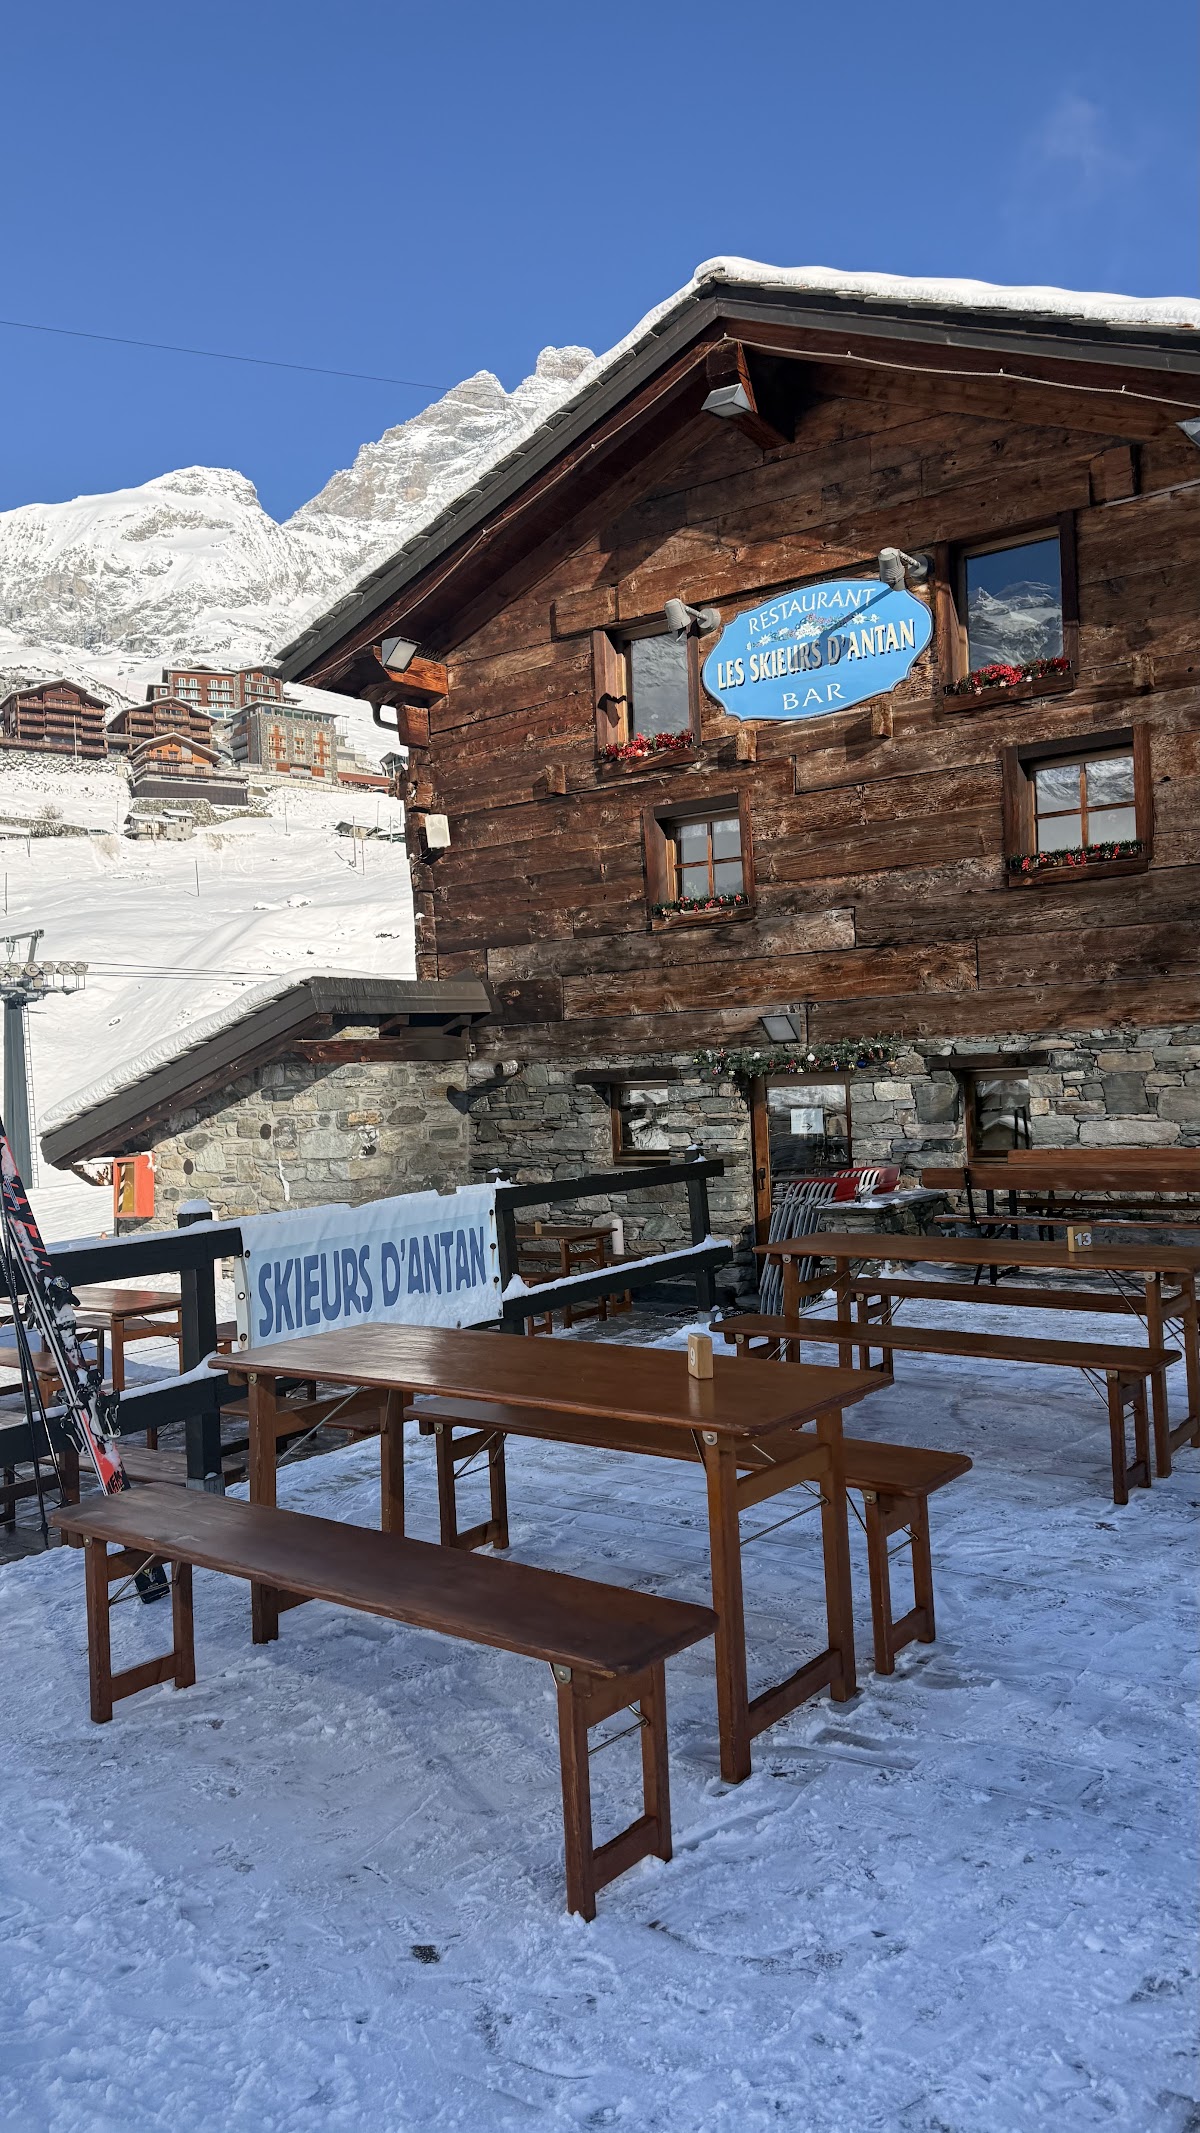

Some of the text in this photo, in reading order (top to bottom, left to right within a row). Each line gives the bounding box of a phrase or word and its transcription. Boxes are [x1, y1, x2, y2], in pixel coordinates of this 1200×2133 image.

[748, 588, 877, 635] RESTAURANT
[717, 618, 916, 690] LES SKIEURS D'ANTAN
[782, 683, 846, 711] BAR
[1074, 1232, 1092, 1246] 13
[258, 1226, 487, 1338] SKIEURS D'ANTAN
[690, 1346, 696, 1367] 9
